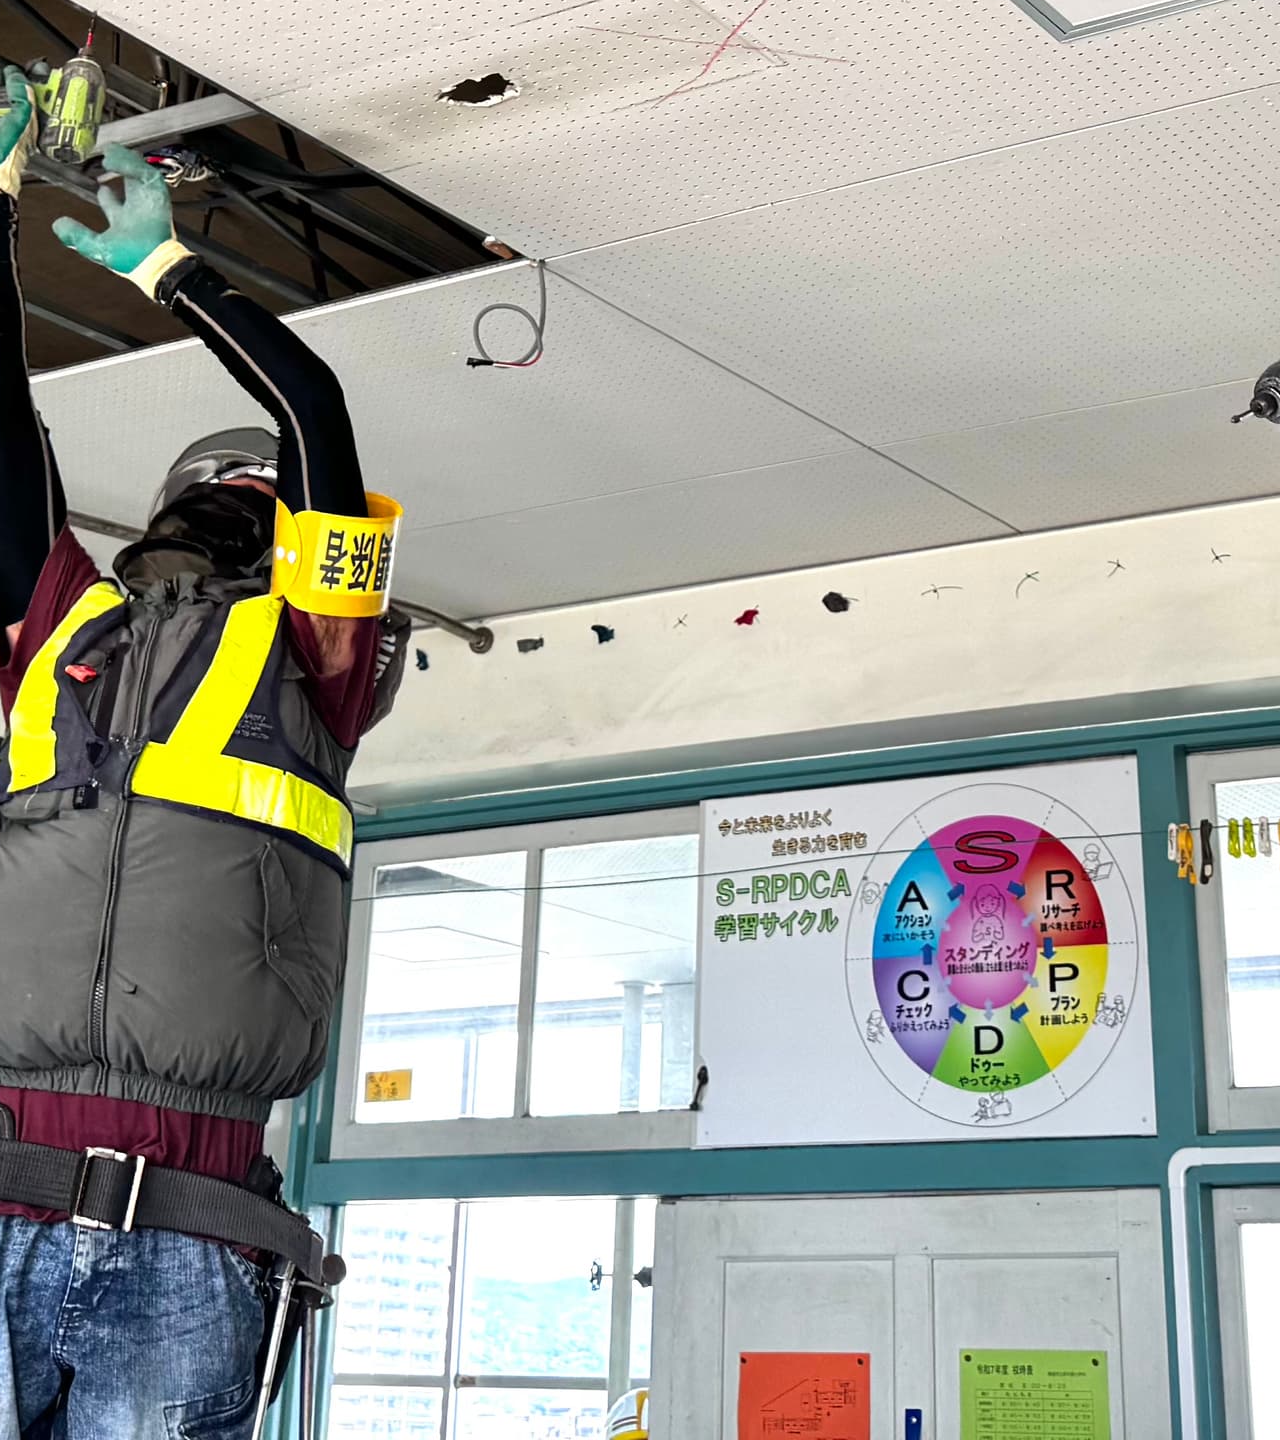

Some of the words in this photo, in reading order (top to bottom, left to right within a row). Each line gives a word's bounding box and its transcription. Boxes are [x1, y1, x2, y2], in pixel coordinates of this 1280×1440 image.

[718, 808, 832, 837] 今と未来をよりよく
[771, 832, 868, 856] 生きる力を育む
[953, 831, 1019, 874] S
[716, 868, 851, 907] S-RPDCA
[897, 880, 929, 912] A
[1045, 869, 1076, 900] R
[895, 914, 932, 929] アクション
[1042, 903, 1080, 919] リサーチ
[714, 908, 839, 942] 学習サイクル
[945, 941, 1030, 962] スタンディング
[897, 969, 930, 1001] C
[1049, 963, 1079, 993] P
[895, 1003, 932, 1018] チェック
[1051, 996, 1081, 1010] プラン
[1040, 1014, 1088, 1026] 計画しよう
[974, 1025, 1004, 1055] D
[971, 1057, 1005, 1073] ドゥー
[959, 1073, 1021, 1087] やってみよう
